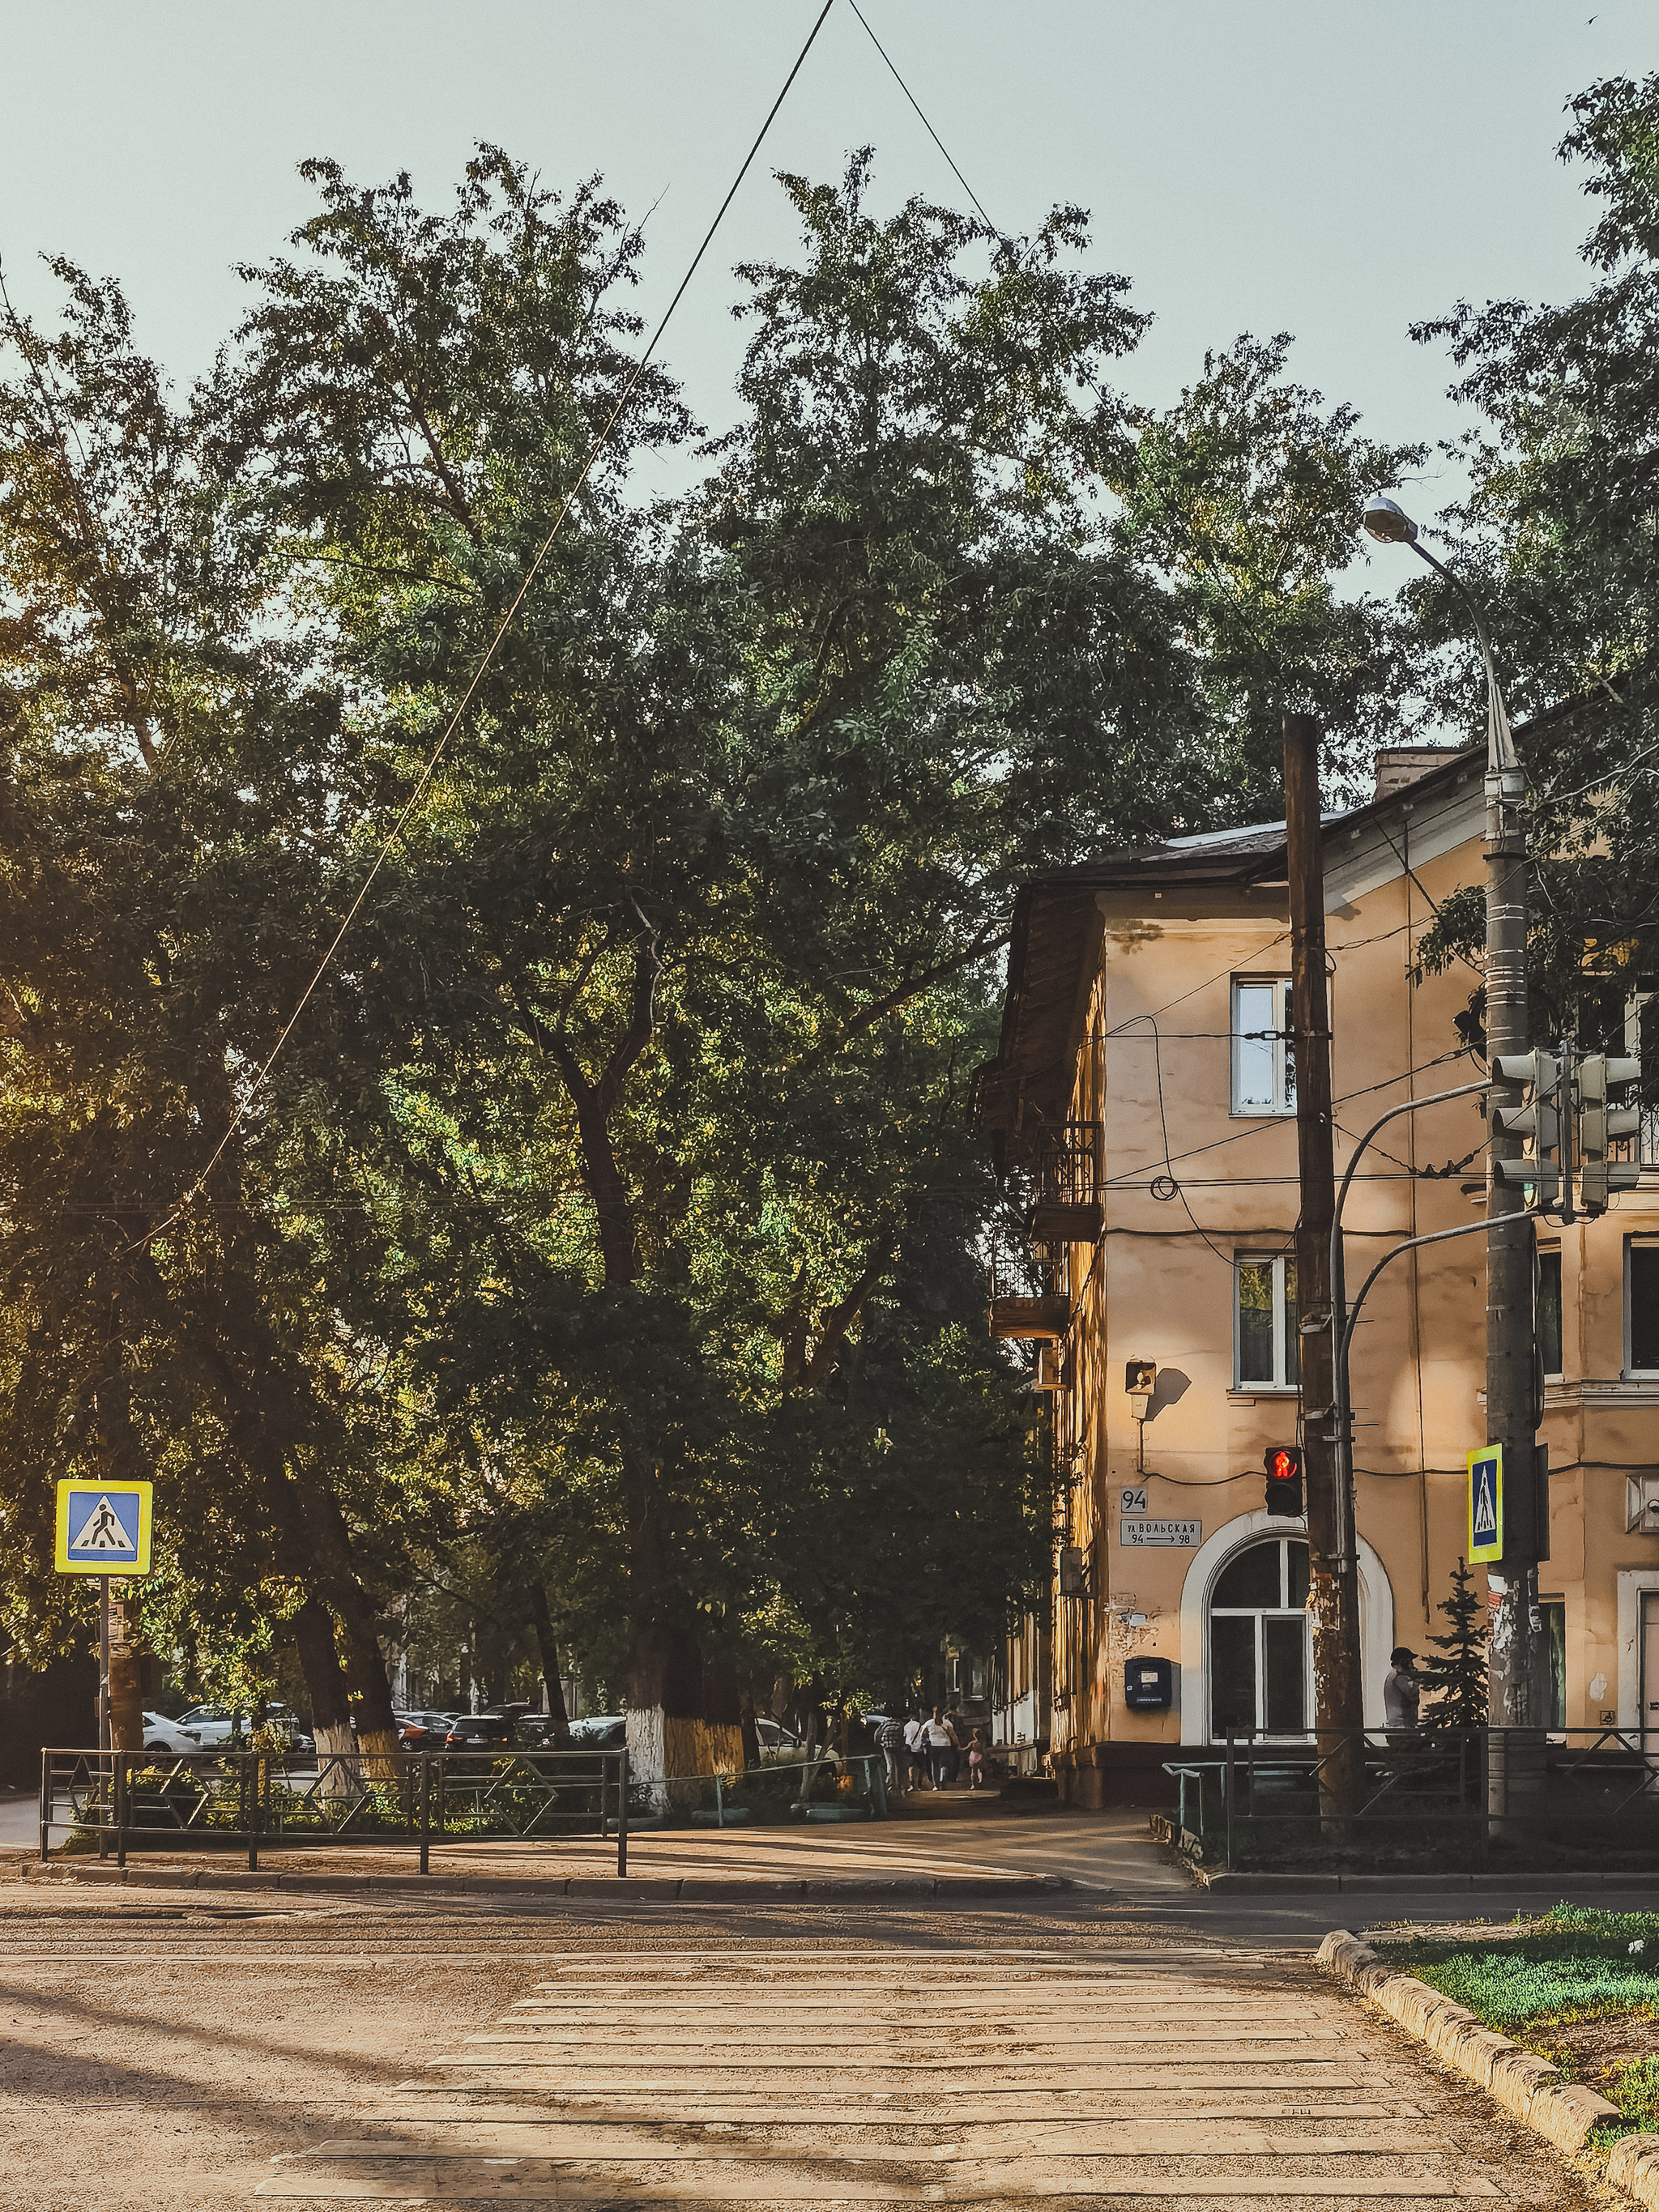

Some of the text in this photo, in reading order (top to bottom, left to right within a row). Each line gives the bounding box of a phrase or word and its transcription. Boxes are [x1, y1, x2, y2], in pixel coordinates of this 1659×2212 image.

[1123, 1490, 1145, 1509] 94
[1139, 1524, 1195, 1533] ВОЛЬСКАЯ
[1132, 1534, 1190, 1544] 94 98
